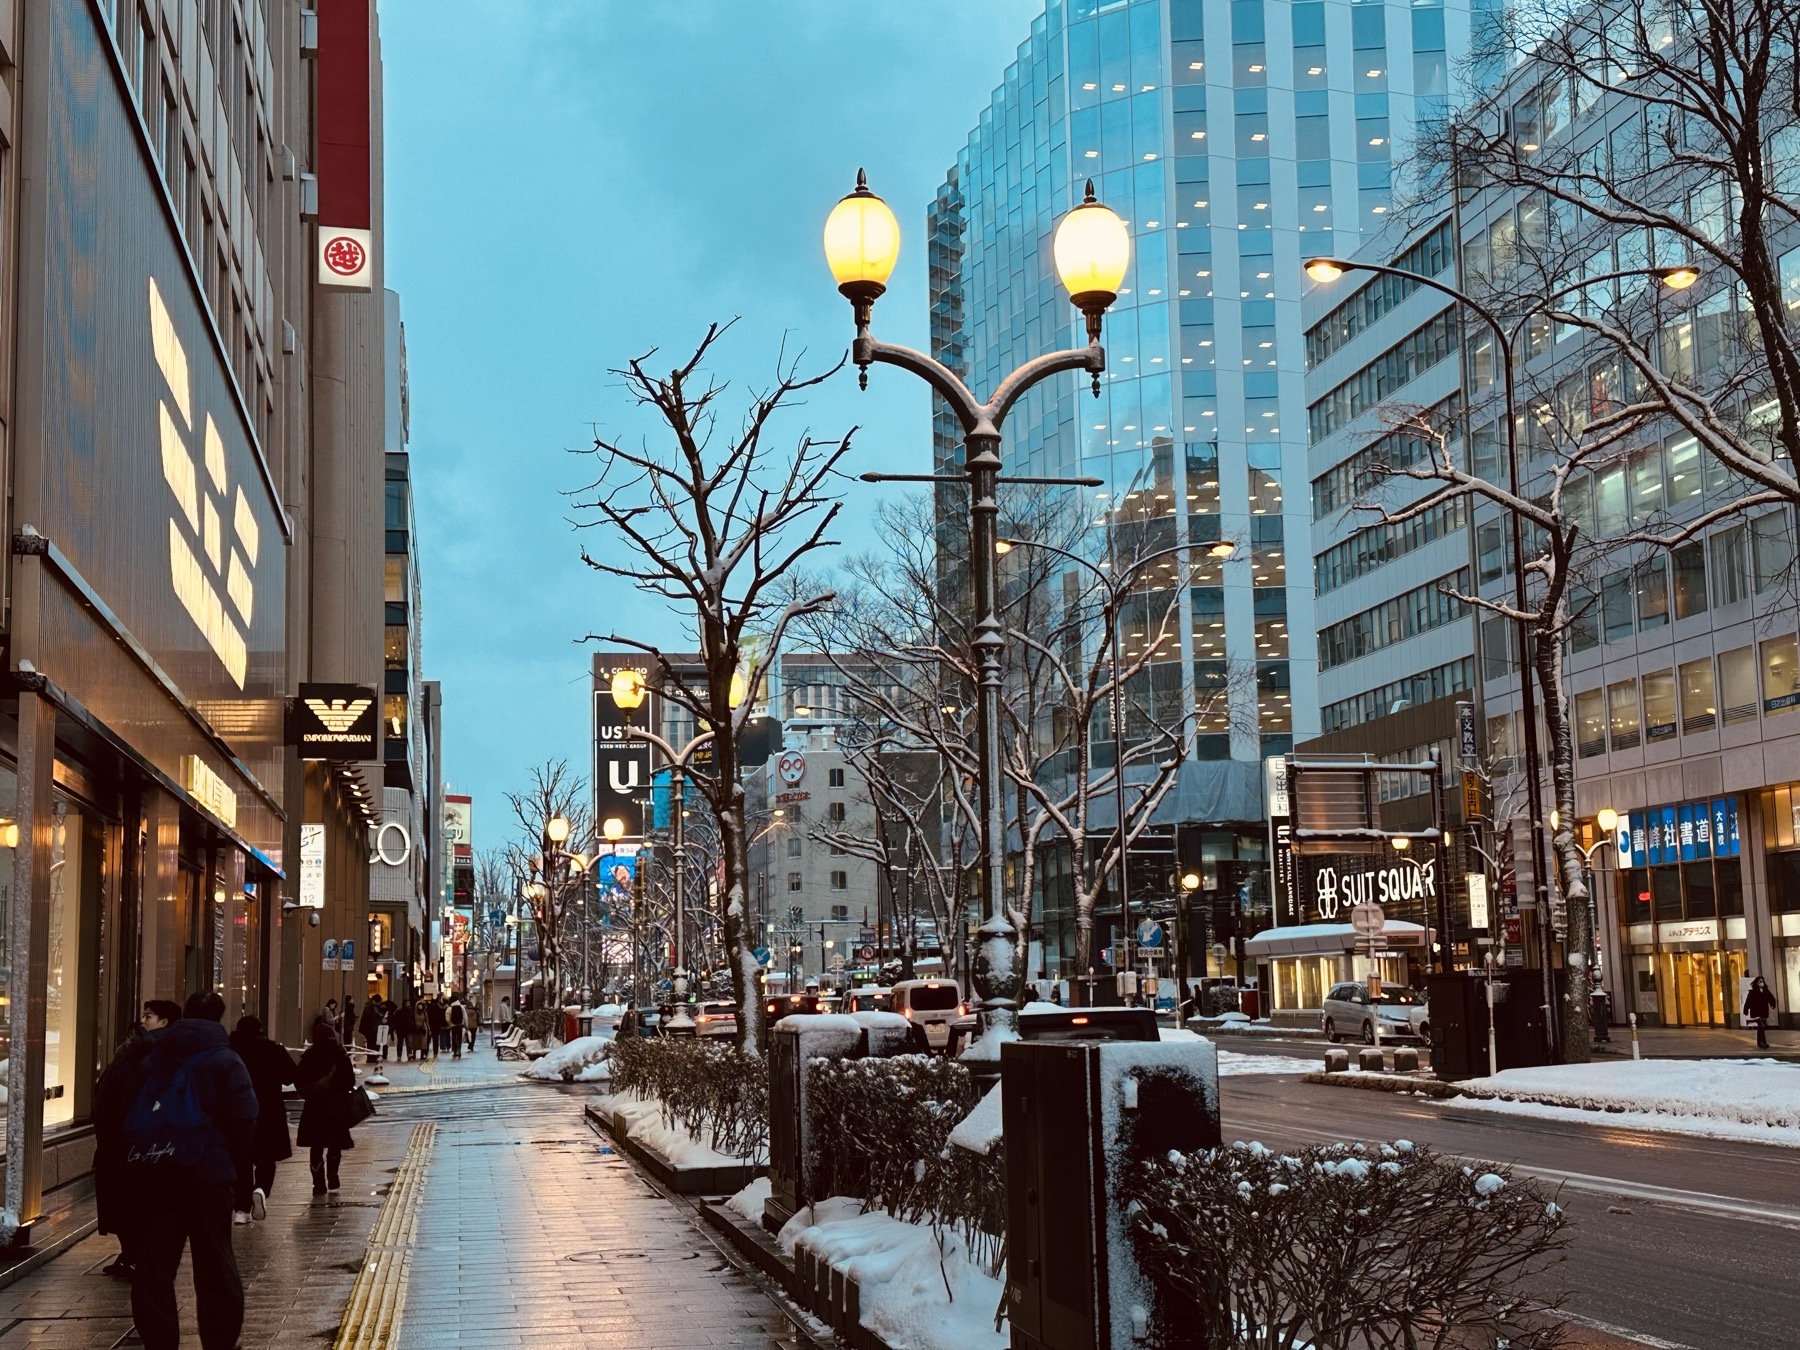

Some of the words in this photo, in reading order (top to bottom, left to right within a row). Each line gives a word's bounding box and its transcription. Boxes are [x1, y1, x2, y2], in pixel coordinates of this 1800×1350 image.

[303, 734, 336, 742] EMPORIO
[344, 734, 372, 742] ARMANI
[609, 760, 639, 795] U
[1341, 871, 1375, 907] SUIT
[1378, 864, 1436, 903] SQUAR
[303, 895, 315, 903] 12
